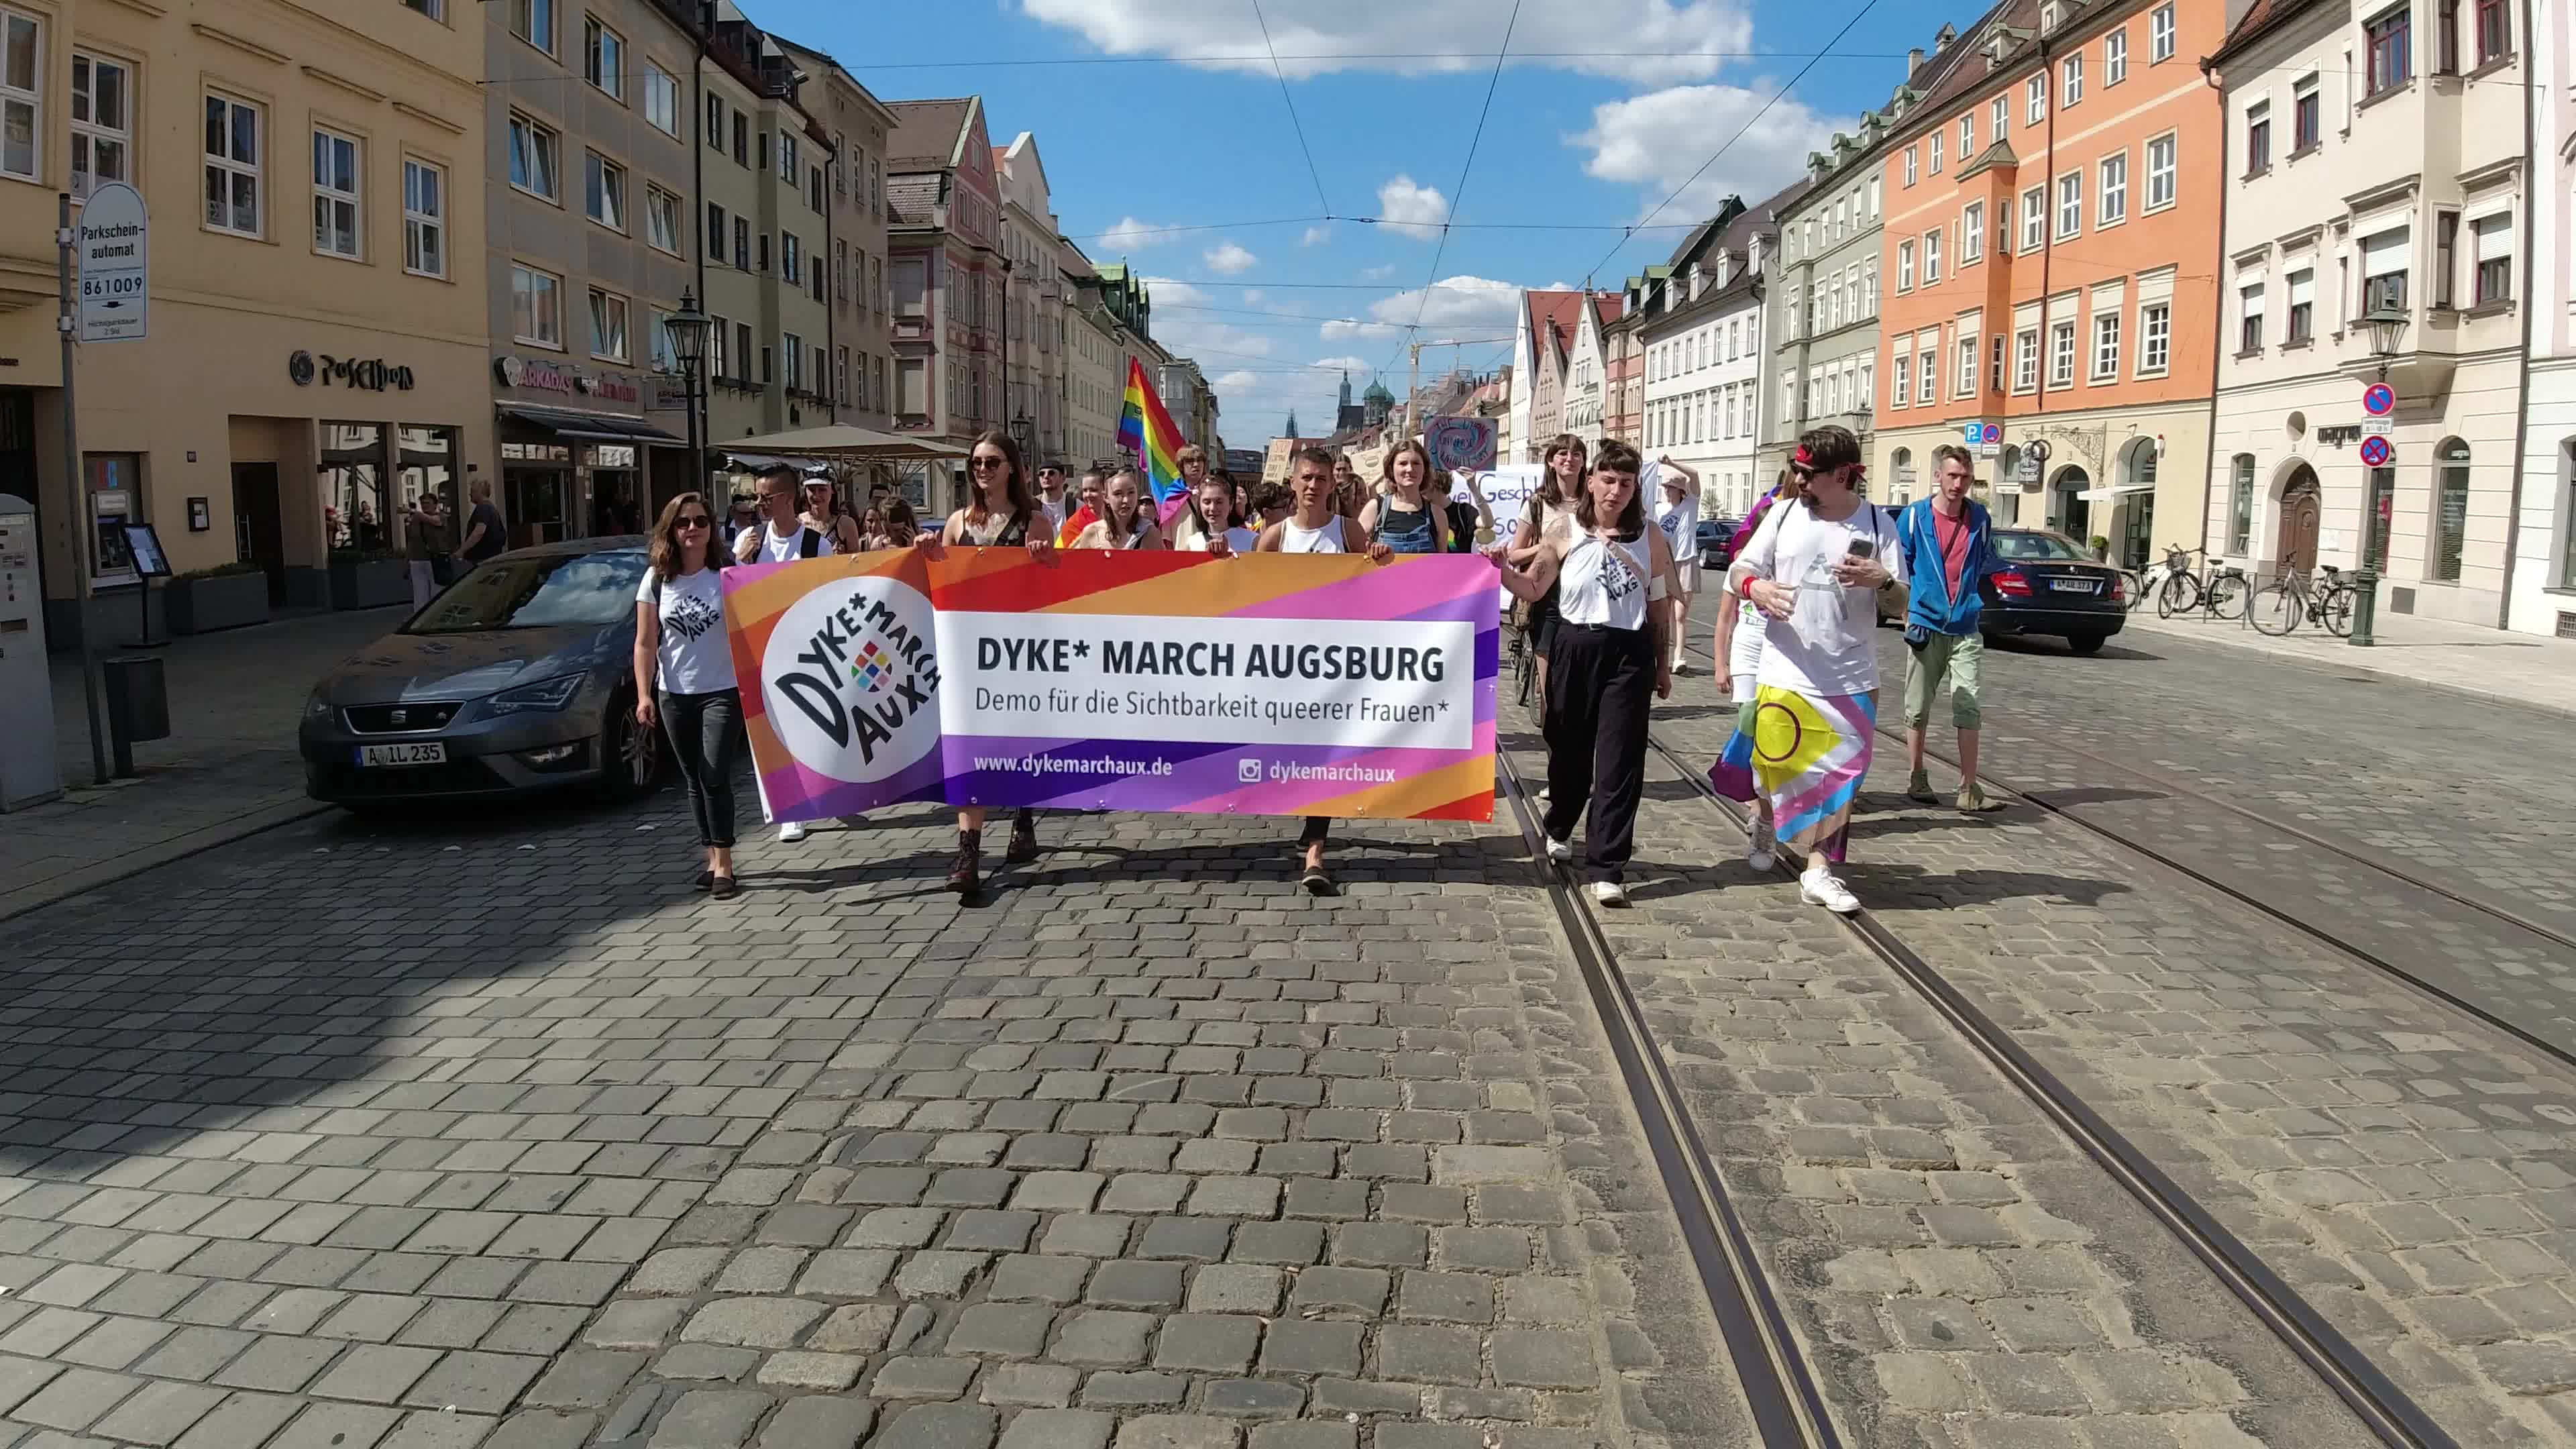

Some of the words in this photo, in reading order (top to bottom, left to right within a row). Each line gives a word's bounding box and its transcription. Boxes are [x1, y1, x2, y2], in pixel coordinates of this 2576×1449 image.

[81, 222, 145, 240] Parkschein-
[91, 244, 135, 258] automat
[84, 277, 142, 295] 861009
[1967, 425, 1978, 441] P
[688, 616, 713, 642] AUX
[864, 600, 942, 694] MARCH
[1103, 640, 1234, 677] MARCH
[1244, 643, 1444, 682] AUGSBURG
[976, 687, 1041, 711] Demo
[1049, 687, 1079, 713] für
[1085, 688, 1119, 714] die
[1126, 690, 1258, 718] Sichtbarkeit
[1265, 699, 1354, 726] queerer
[851, 674, 930, 766] AUX
[369, 747, 378, 764] A
[411, 745, 441, 761] 235
[974, 752, 1173, 777] www.dykemarchaux.de
[1269, 760, 1396, 784] dykemarchaux
